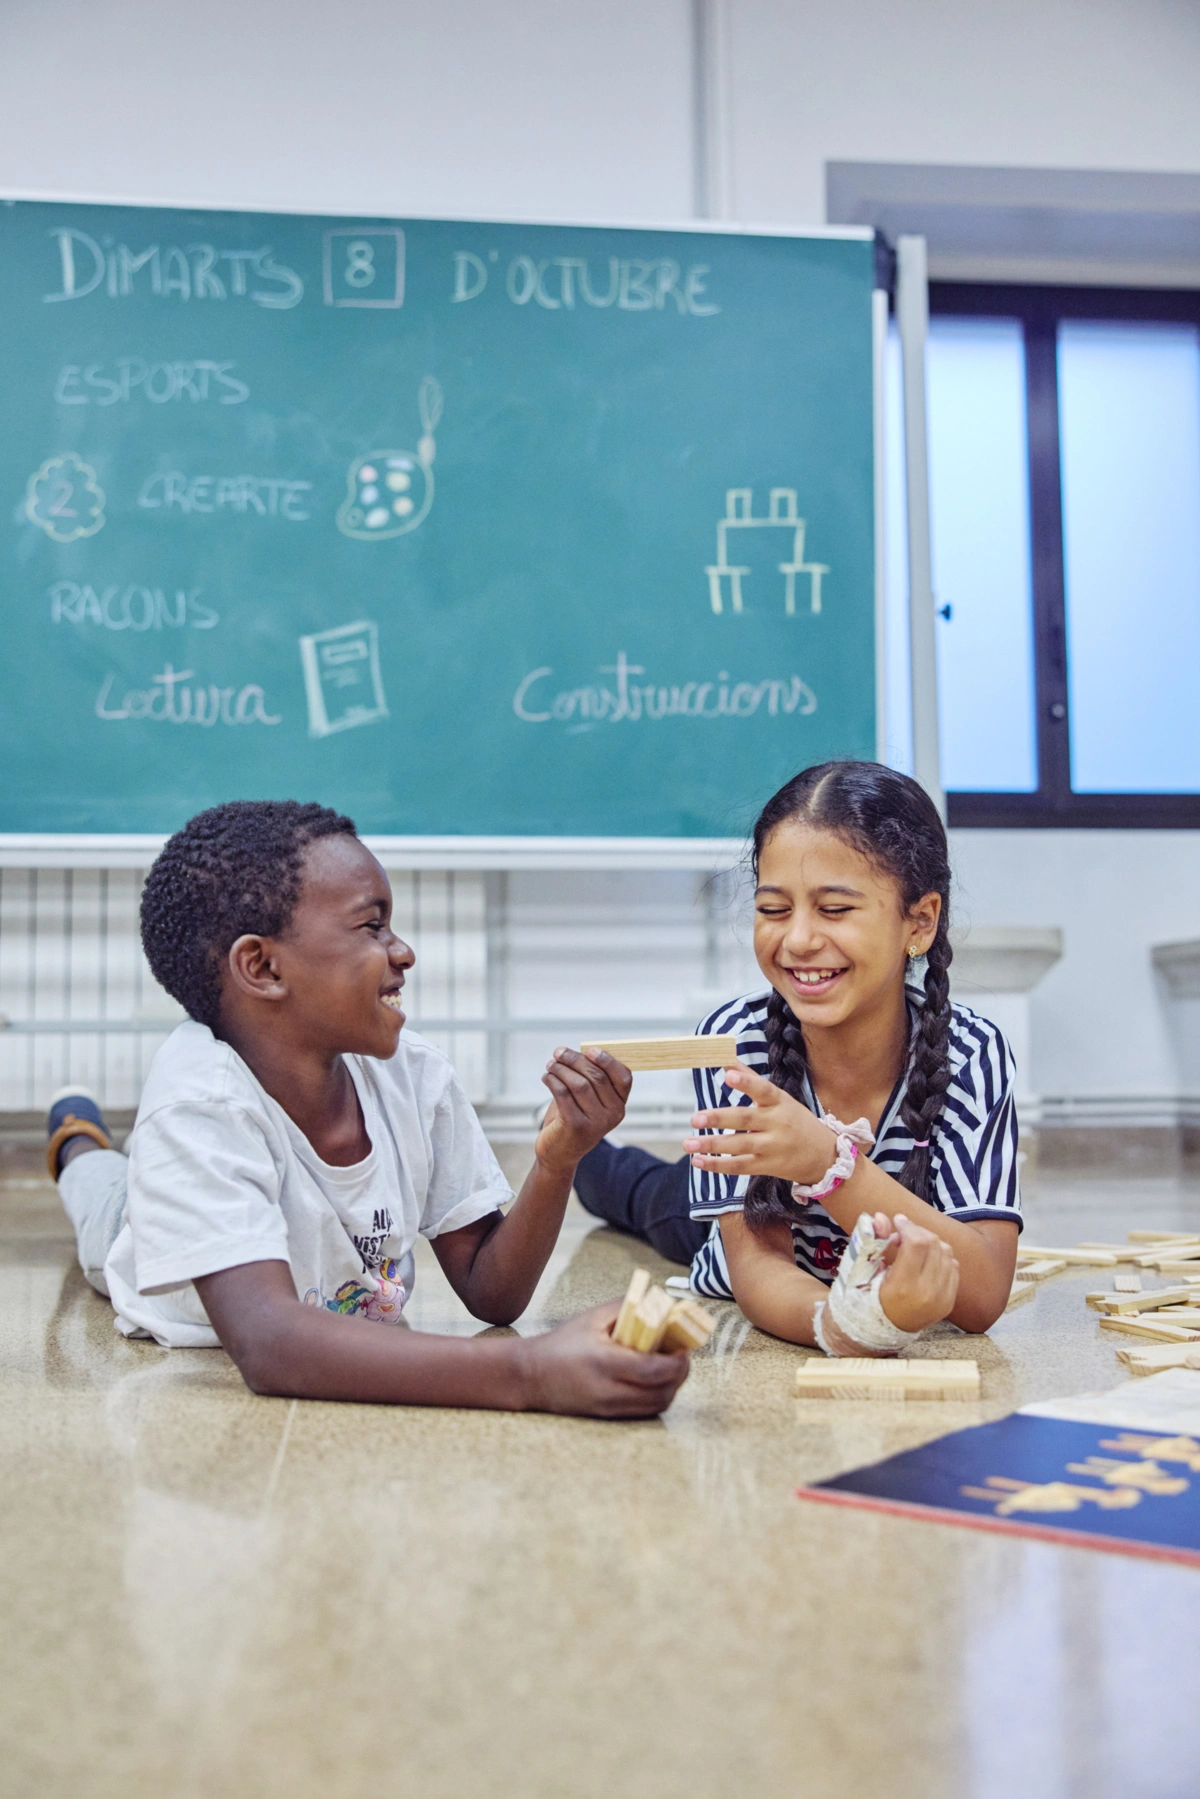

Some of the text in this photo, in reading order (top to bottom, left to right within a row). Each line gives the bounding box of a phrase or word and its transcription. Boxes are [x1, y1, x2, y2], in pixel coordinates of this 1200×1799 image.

[344, 240, 375, 288] 8
[54, 356, 250, 405] ESPORTS
[48, 480, 78, 517] 2
[48, 580, 220, 631] RACONS
[95, 663, 282, 727] Lectura
[513, 650, 818, 722] Construccions
